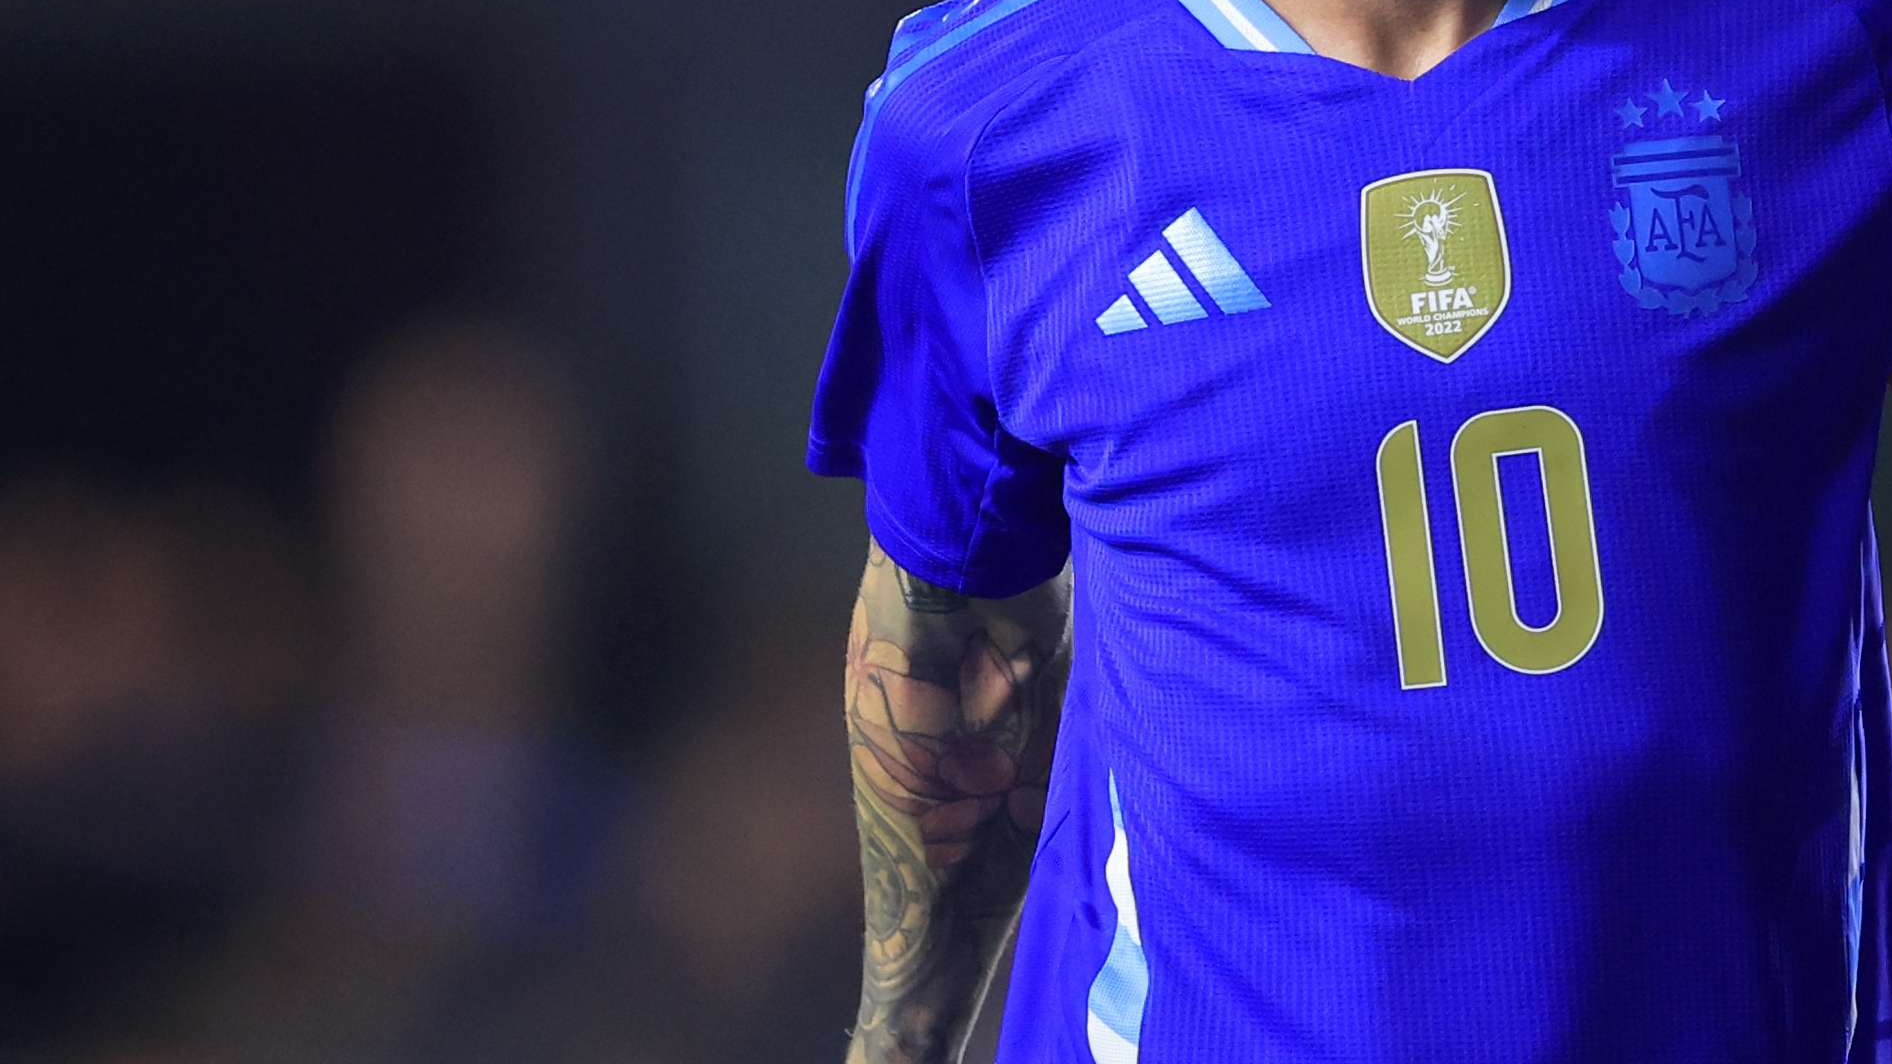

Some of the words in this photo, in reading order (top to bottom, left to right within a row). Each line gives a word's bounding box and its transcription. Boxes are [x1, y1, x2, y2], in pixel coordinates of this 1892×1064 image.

[1645, 185, 1727, 263] AFA
[1410, 287, 1474, 315] FIFA
[1396, 315, 1431, 326] WORLD
[1433, 307, 1490, 322] CHAMPIONS
[1424, 320, 1463, 336] 2022
[1375, 405, 1604, 690] 10
